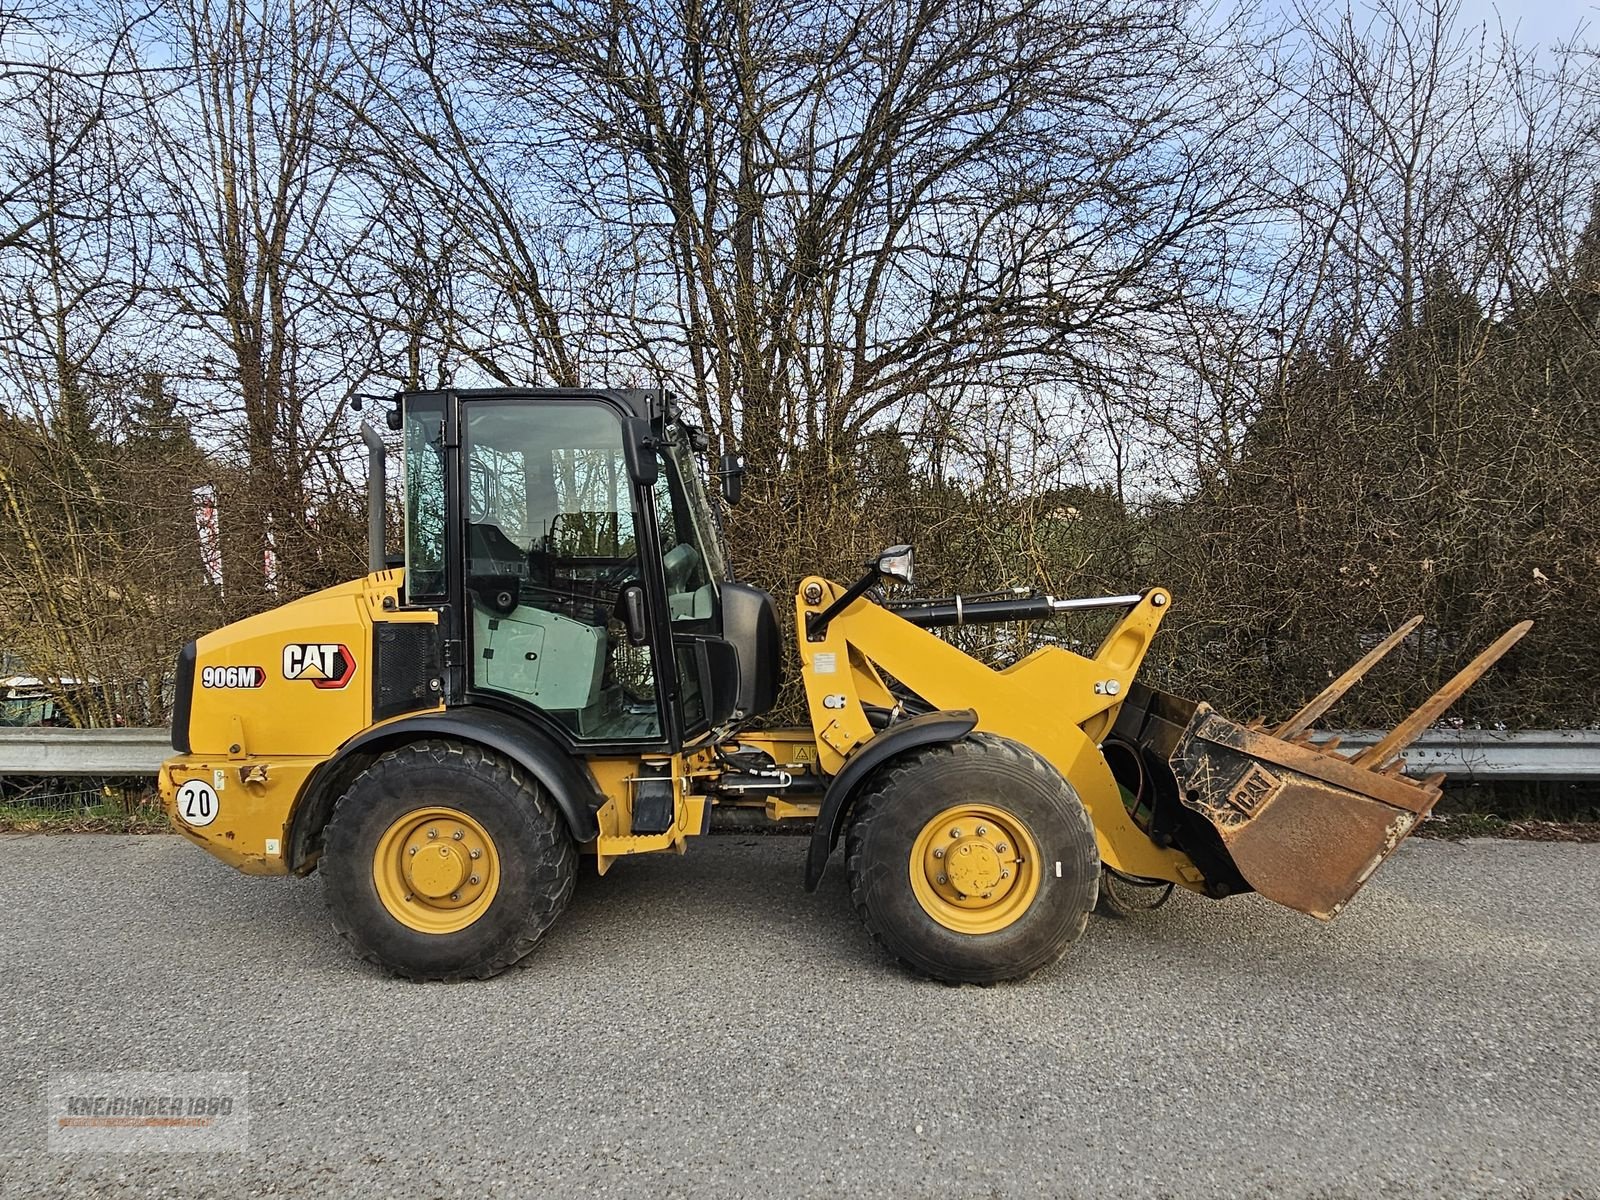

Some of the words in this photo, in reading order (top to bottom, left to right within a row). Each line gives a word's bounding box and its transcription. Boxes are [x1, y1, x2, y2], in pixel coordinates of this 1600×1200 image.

[284, 645, 338, 678] CAT
[203, 667, 255, 687] 906M
[185, 789, 210, 817] 20
[1235, 770, 1272, 810] CAT
